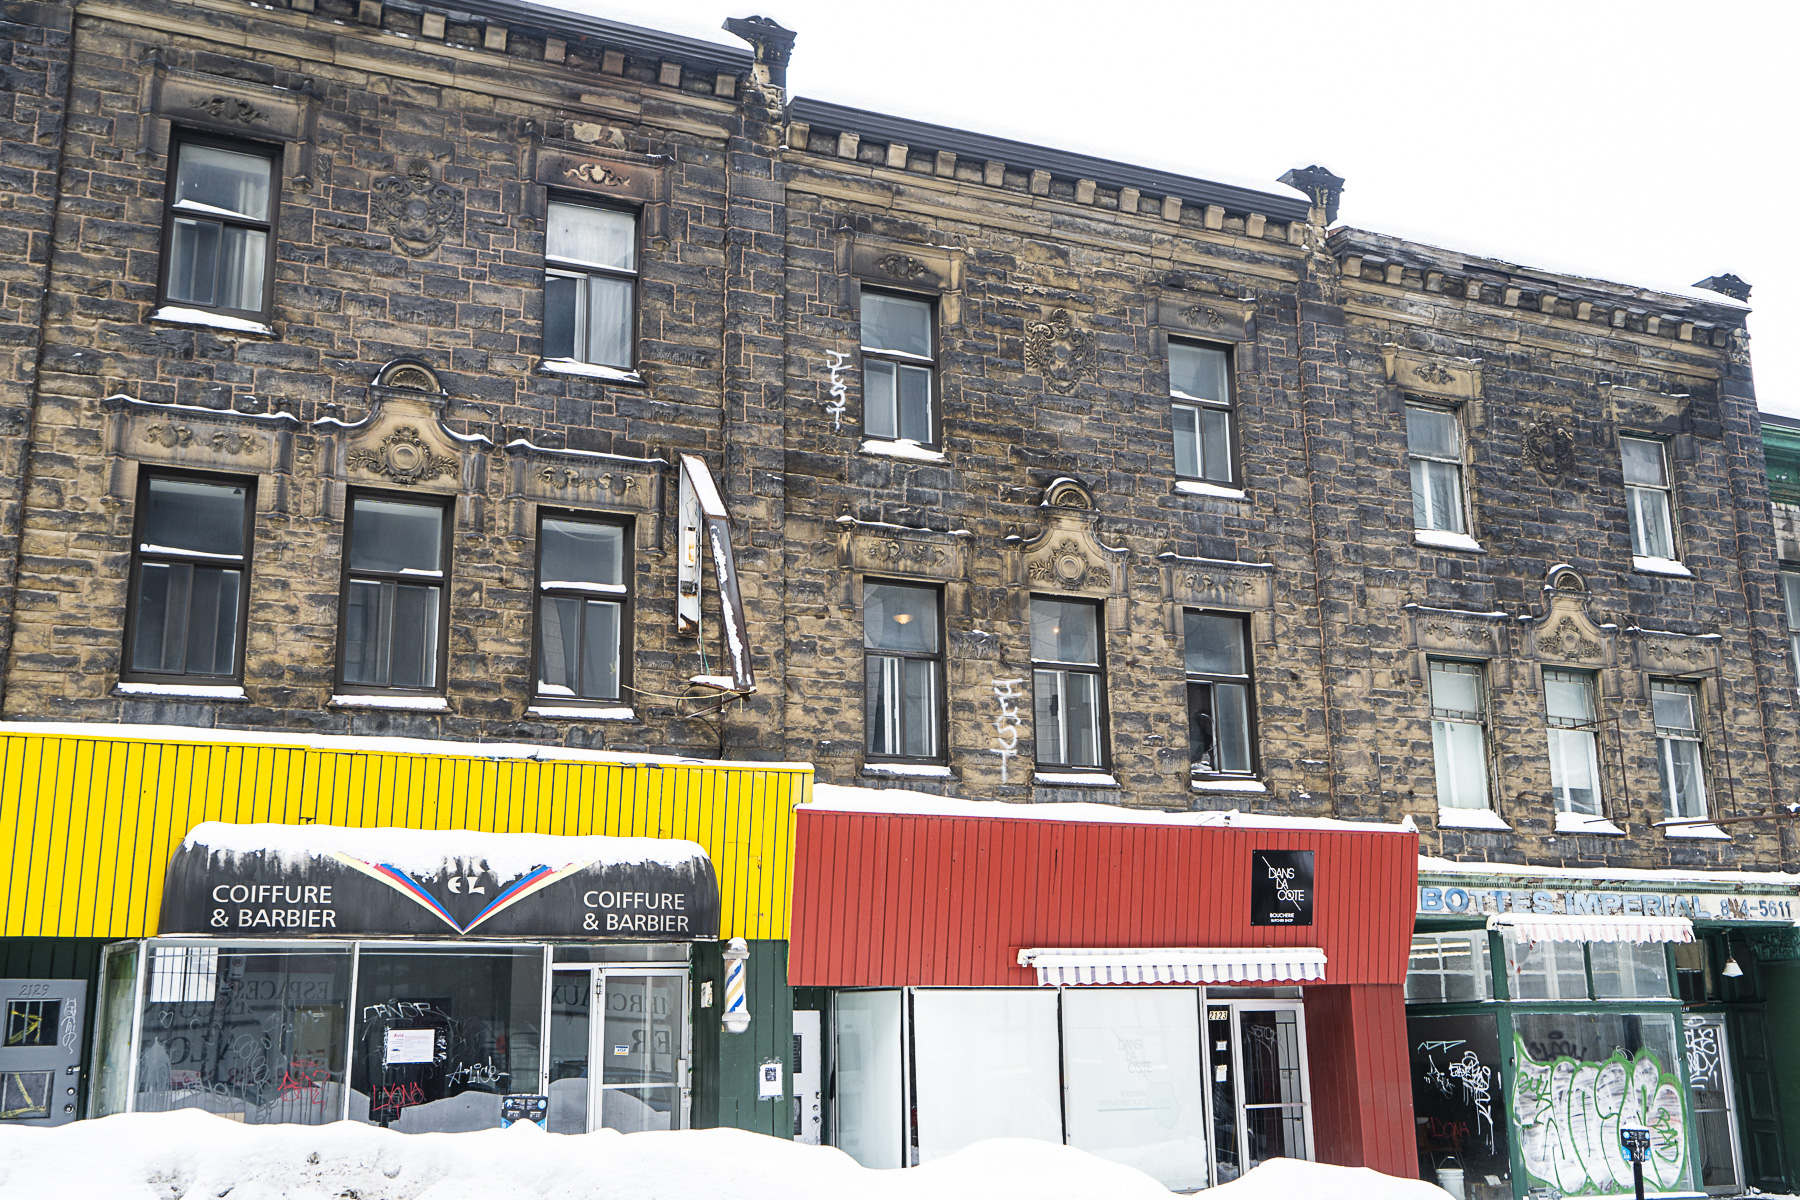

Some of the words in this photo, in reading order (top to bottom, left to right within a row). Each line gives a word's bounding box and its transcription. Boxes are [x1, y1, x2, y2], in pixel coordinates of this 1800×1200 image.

[1268, 867, 1295, 879] DANS
[212, 884, 332, 904] COIFFURE
[583, 890, 685, 910] COIFFURE
[1421, 887, 1554, 915] BOTTES
[1564, 892, 1711, 919] IMPERIAL
[210, 908, 229, 928] &
[238, 908, 337, 928] BARBIER
[583, 912, 599, 931] &
[606, 913, 689, 932] BARBIER
[19, 984, 50, 997] 2129
[1209, 1011, 1228, 1020] 2123
